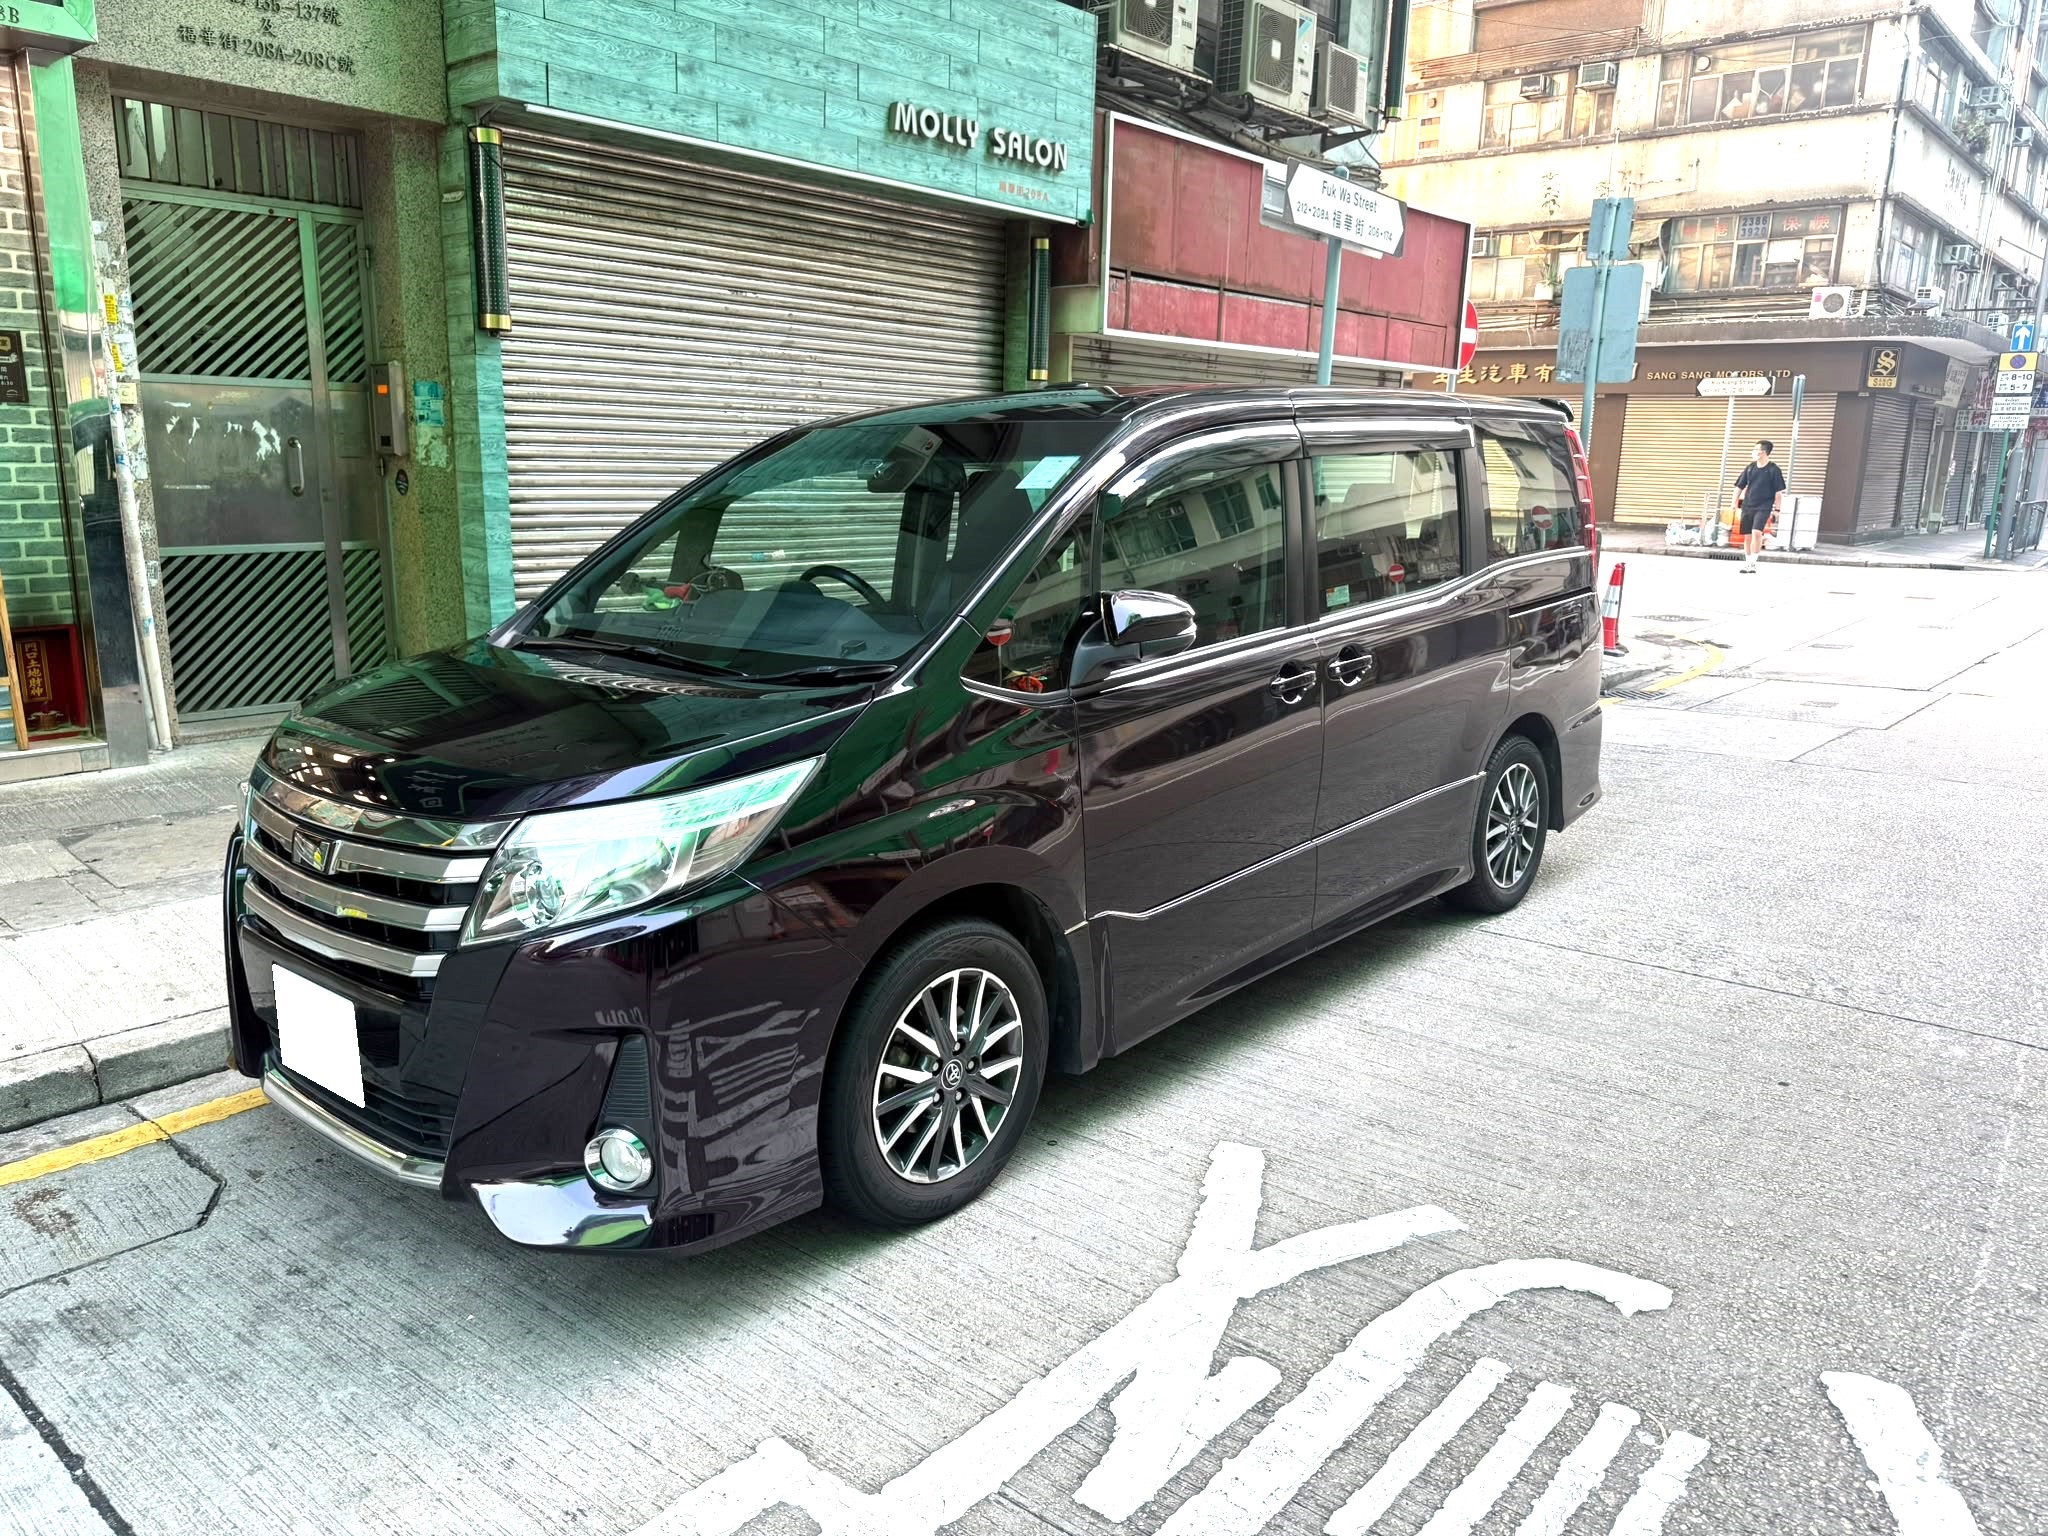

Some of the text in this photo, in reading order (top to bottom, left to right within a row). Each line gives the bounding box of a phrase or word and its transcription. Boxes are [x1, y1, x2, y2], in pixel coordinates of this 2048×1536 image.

[260, 18, 277, 38] 及
[890, 101, 1068, 172] MOLLY SALON
[1321, 180, 1378, 214] Fuk Wa Street
[1332, 209, 1365, 237] 福華街
[1741, 216, 1768, 227] 2386
[1740, 227, 1767, 238] 3920
[1647, 371, 1677, 381] SANG
[1680, 370, 1712, 380] SANG
[2011, 373, 2033, 381] 8-10
[25, 641, 44, 697] 門口土地財神
